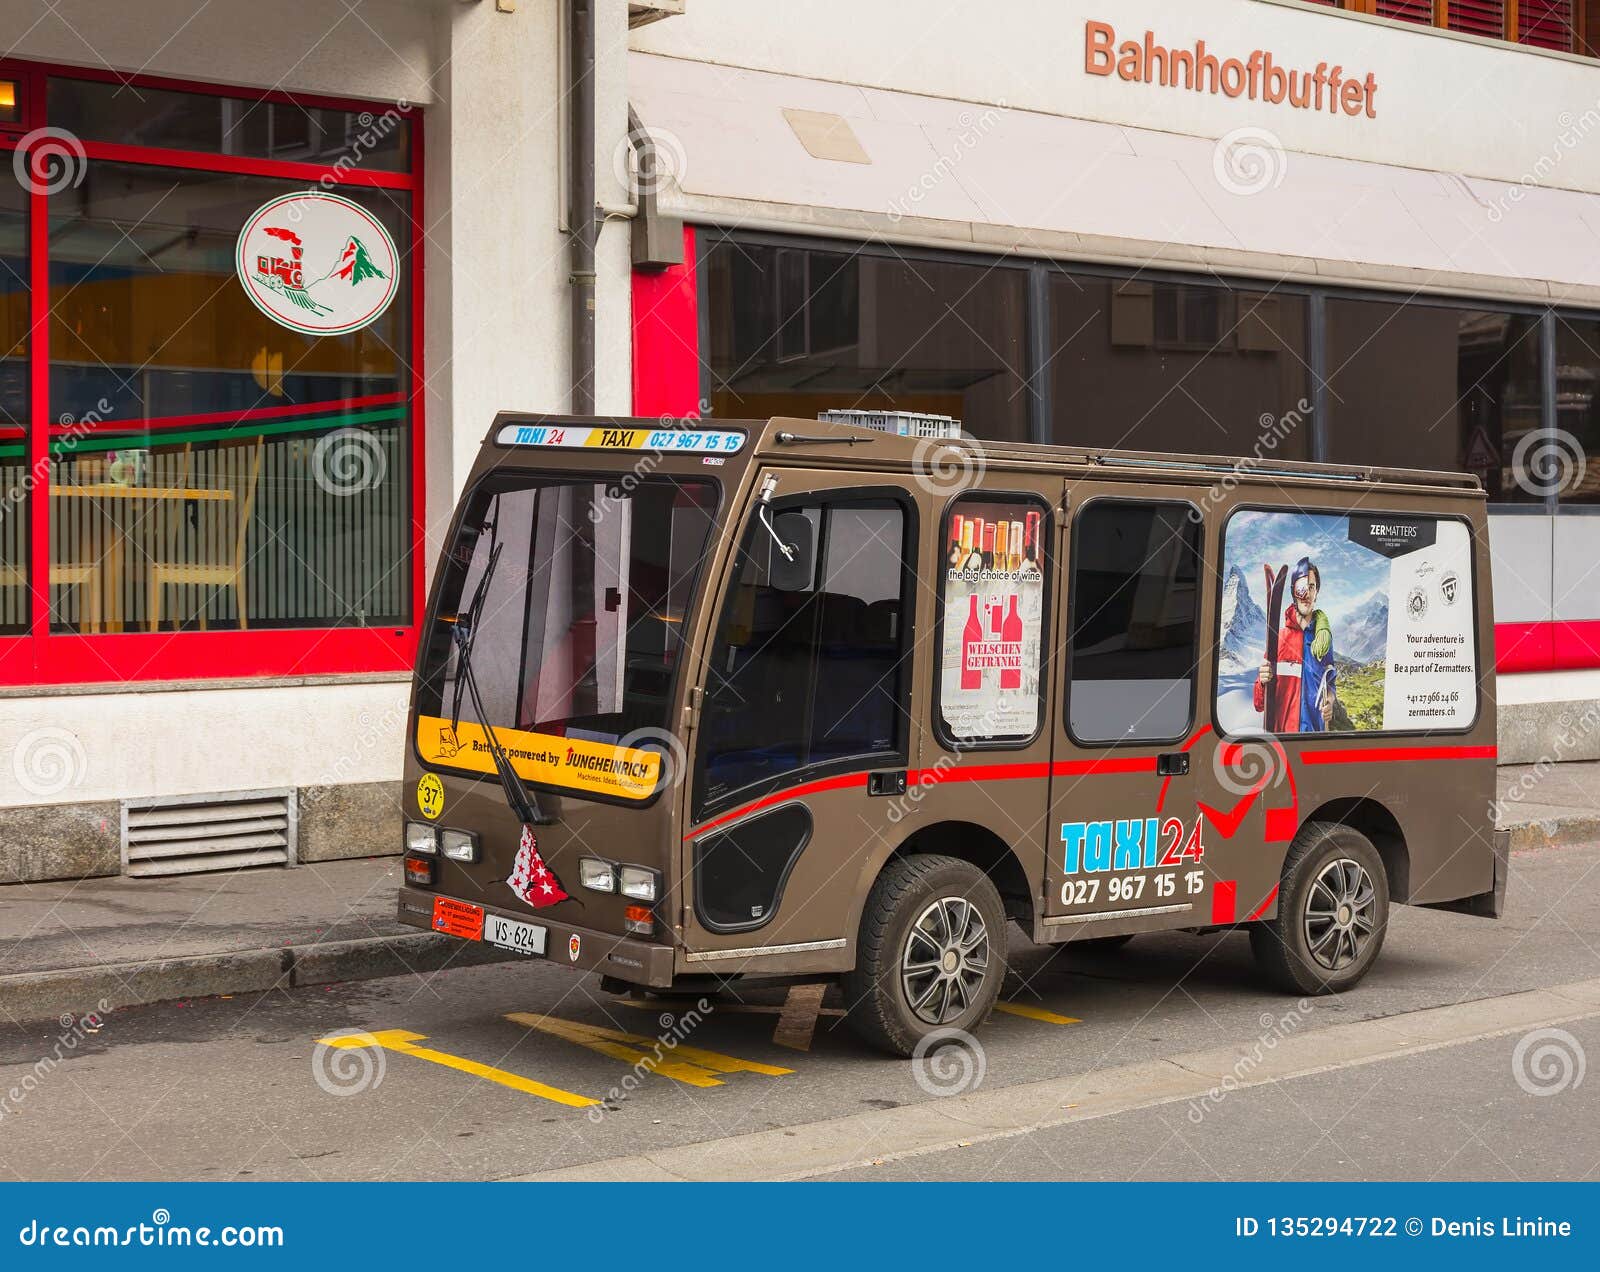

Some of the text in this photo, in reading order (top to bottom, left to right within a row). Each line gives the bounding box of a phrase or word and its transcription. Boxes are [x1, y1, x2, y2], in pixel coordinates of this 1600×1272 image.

[1085, 19, 1378, 119] Bahnhofbuffet
[547, 428, 565, 445] 24
[599, 430, 635, 447] TAXI
[649, 432, 742, 450] 027 967 15 15
[1370, 524, 1417, 538] ZERMATTERS
[965, 568, 979, 582] big
[980, 568, 1010, 581] choice
[1021, 569, 1041, 581] wine
[1406, 633, 1465, 644] Your adventure is
[968, 643, 1022, 656] WELSCHEN
[1413, 648, 1457, 659] our mission!
[1394, 663, 1403, 673] Be
[1410, 664, 1424, 675] part
[1425, 663, 1434, 673] of
[1434, 663, 1473, 673] Zermatters.
[1406, 692, 1459, 704] +41 27 966 24 66
[1408, 706, 1456, 717] zermatters.ch
[508, 747, 547, 763] powered
[548, 751, 560, 767] by
[565, 752, 648, 779] JUNGHEINRICH
[424, 786, 438, 805] 37
[1061, 870, 1205, 906] 027 967 15 15
